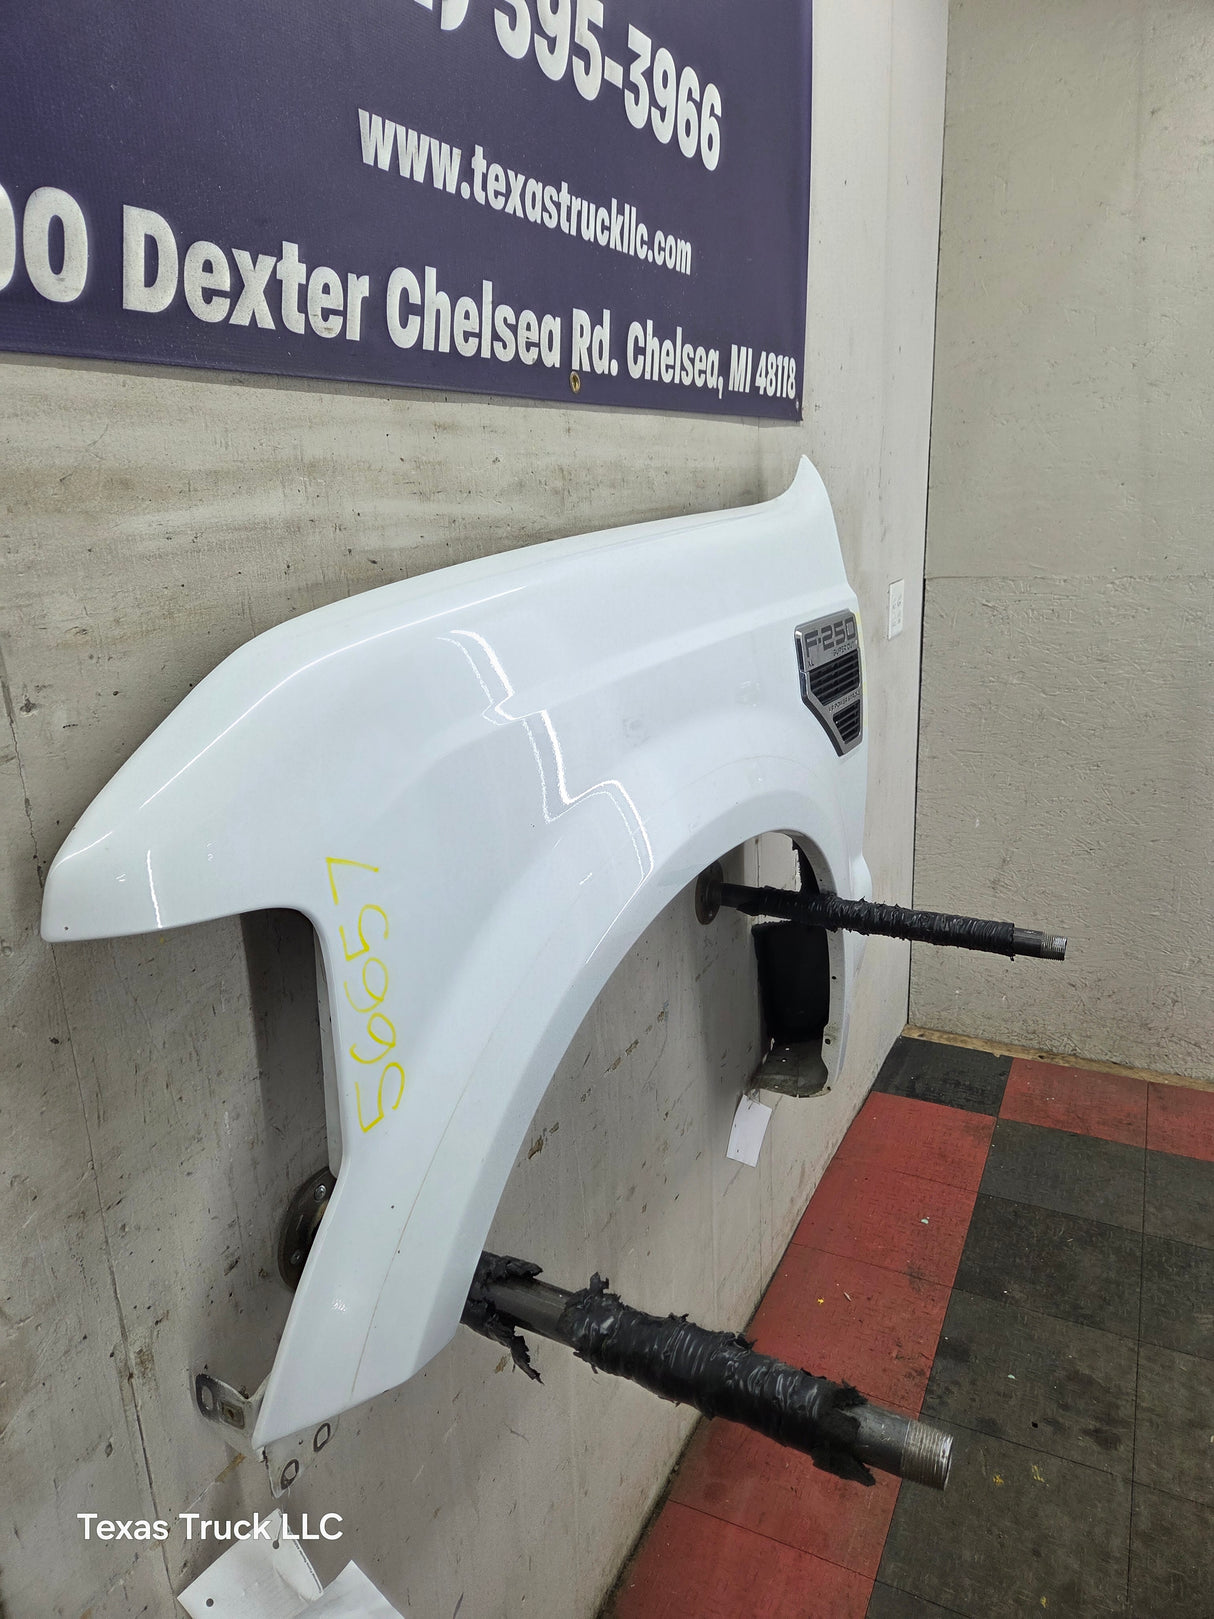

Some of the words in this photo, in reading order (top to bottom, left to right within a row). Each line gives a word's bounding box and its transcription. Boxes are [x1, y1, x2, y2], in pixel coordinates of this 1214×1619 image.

[358, 108, 692, 275] www.texastruckllc.com
[0, 183, 88, 302] 0
[123, 204, 370, 341] Dexter
[386, 266, 562, 369] Chelsea
[571, 308, 619, 377] Rd.
[627, 319, 724, 399] Chelsea,
[728, 344, 753, 393] MI
[755, 351, 797, 399] 48118
[804, 616, 856, 657] F-250
[326, 857, 405, 1133] 56657
